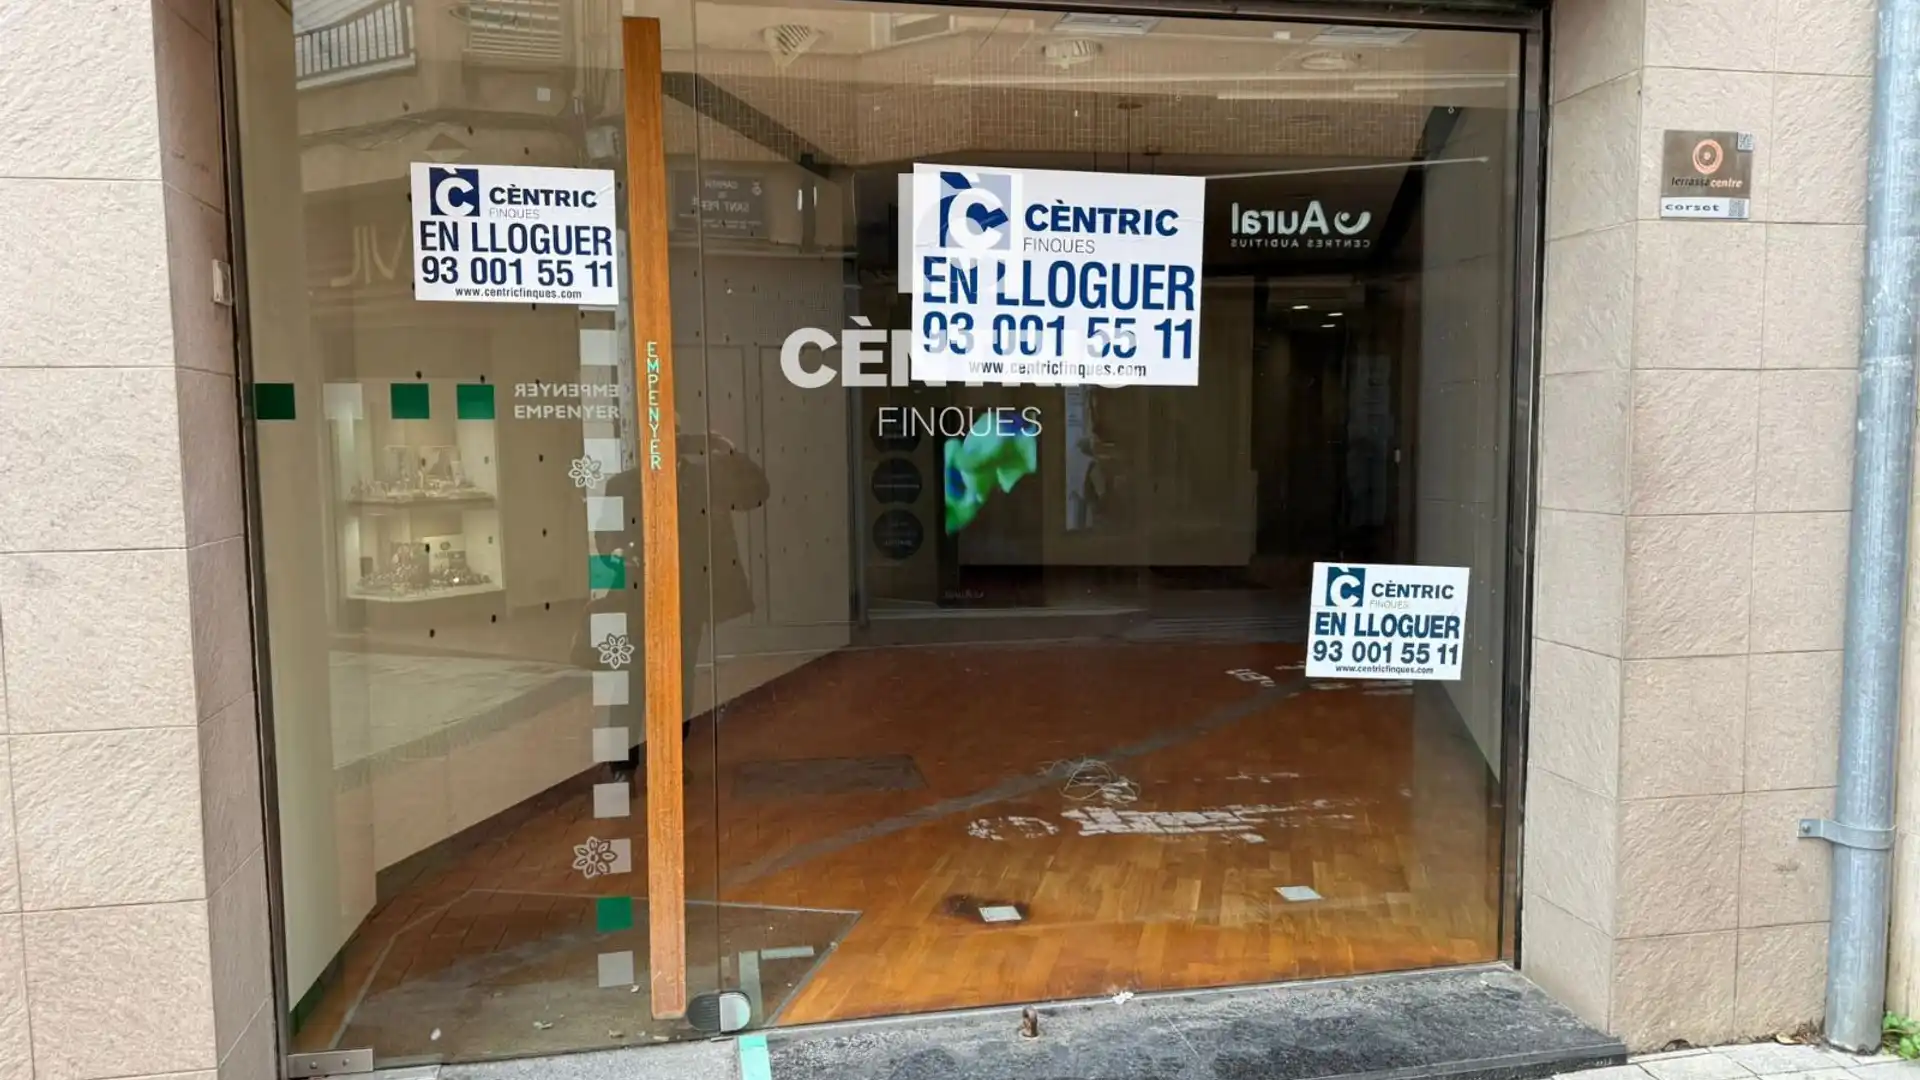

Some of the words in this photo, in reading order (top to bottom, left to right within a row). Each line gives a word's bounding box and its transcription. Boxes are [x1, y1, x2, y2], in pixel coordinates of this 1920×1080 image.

[489, 184, 597, 208] CÈNTRIC
[489, 207, 540, 220] FINQUES
[1024, 199, 1179, 237] CÈNTRIC
[420, 221, 459, 252] EN
[471, 222, 613, 256] LLOGUER
[1023, 237, 1096, 254] FINQUES
[421, 256, 459, 284] 93
[470, 257, 522, 285] 001
[537, 259, 574, 287] 55
[584, 261, 613, 288] 11
[923, 256, 978, 304] EN
[996, 258, 1195, 311] LLOGUER
[455, 287, 582, 300] www.centricfinques.com
[923, 311, 975, 355] 93
[992, 313, 1065, 357] 001
[1087, 317, 1137, 359] 55
[1154, 318, 1193, 359] 11
[969, 360, 1147, 379] www.centricfinques.com
[514, 405, 620, 419] EMPENYER
[646, 341, 661, 470] EMPENYER
[877, 406, 1043, 437] FINQUES
[1314, 611, 1347, 636] EN
[1353, 612, 1461, 639] LLOGUER
[1313, 640, 1343, 662] 93
[1351, 641, 1393, 664] 001
[1400, 642, 1430, 664] 55
[1437, 643, 1458, 665] 11
[1335, 665, 1434, 675] www.centricfinques.com
